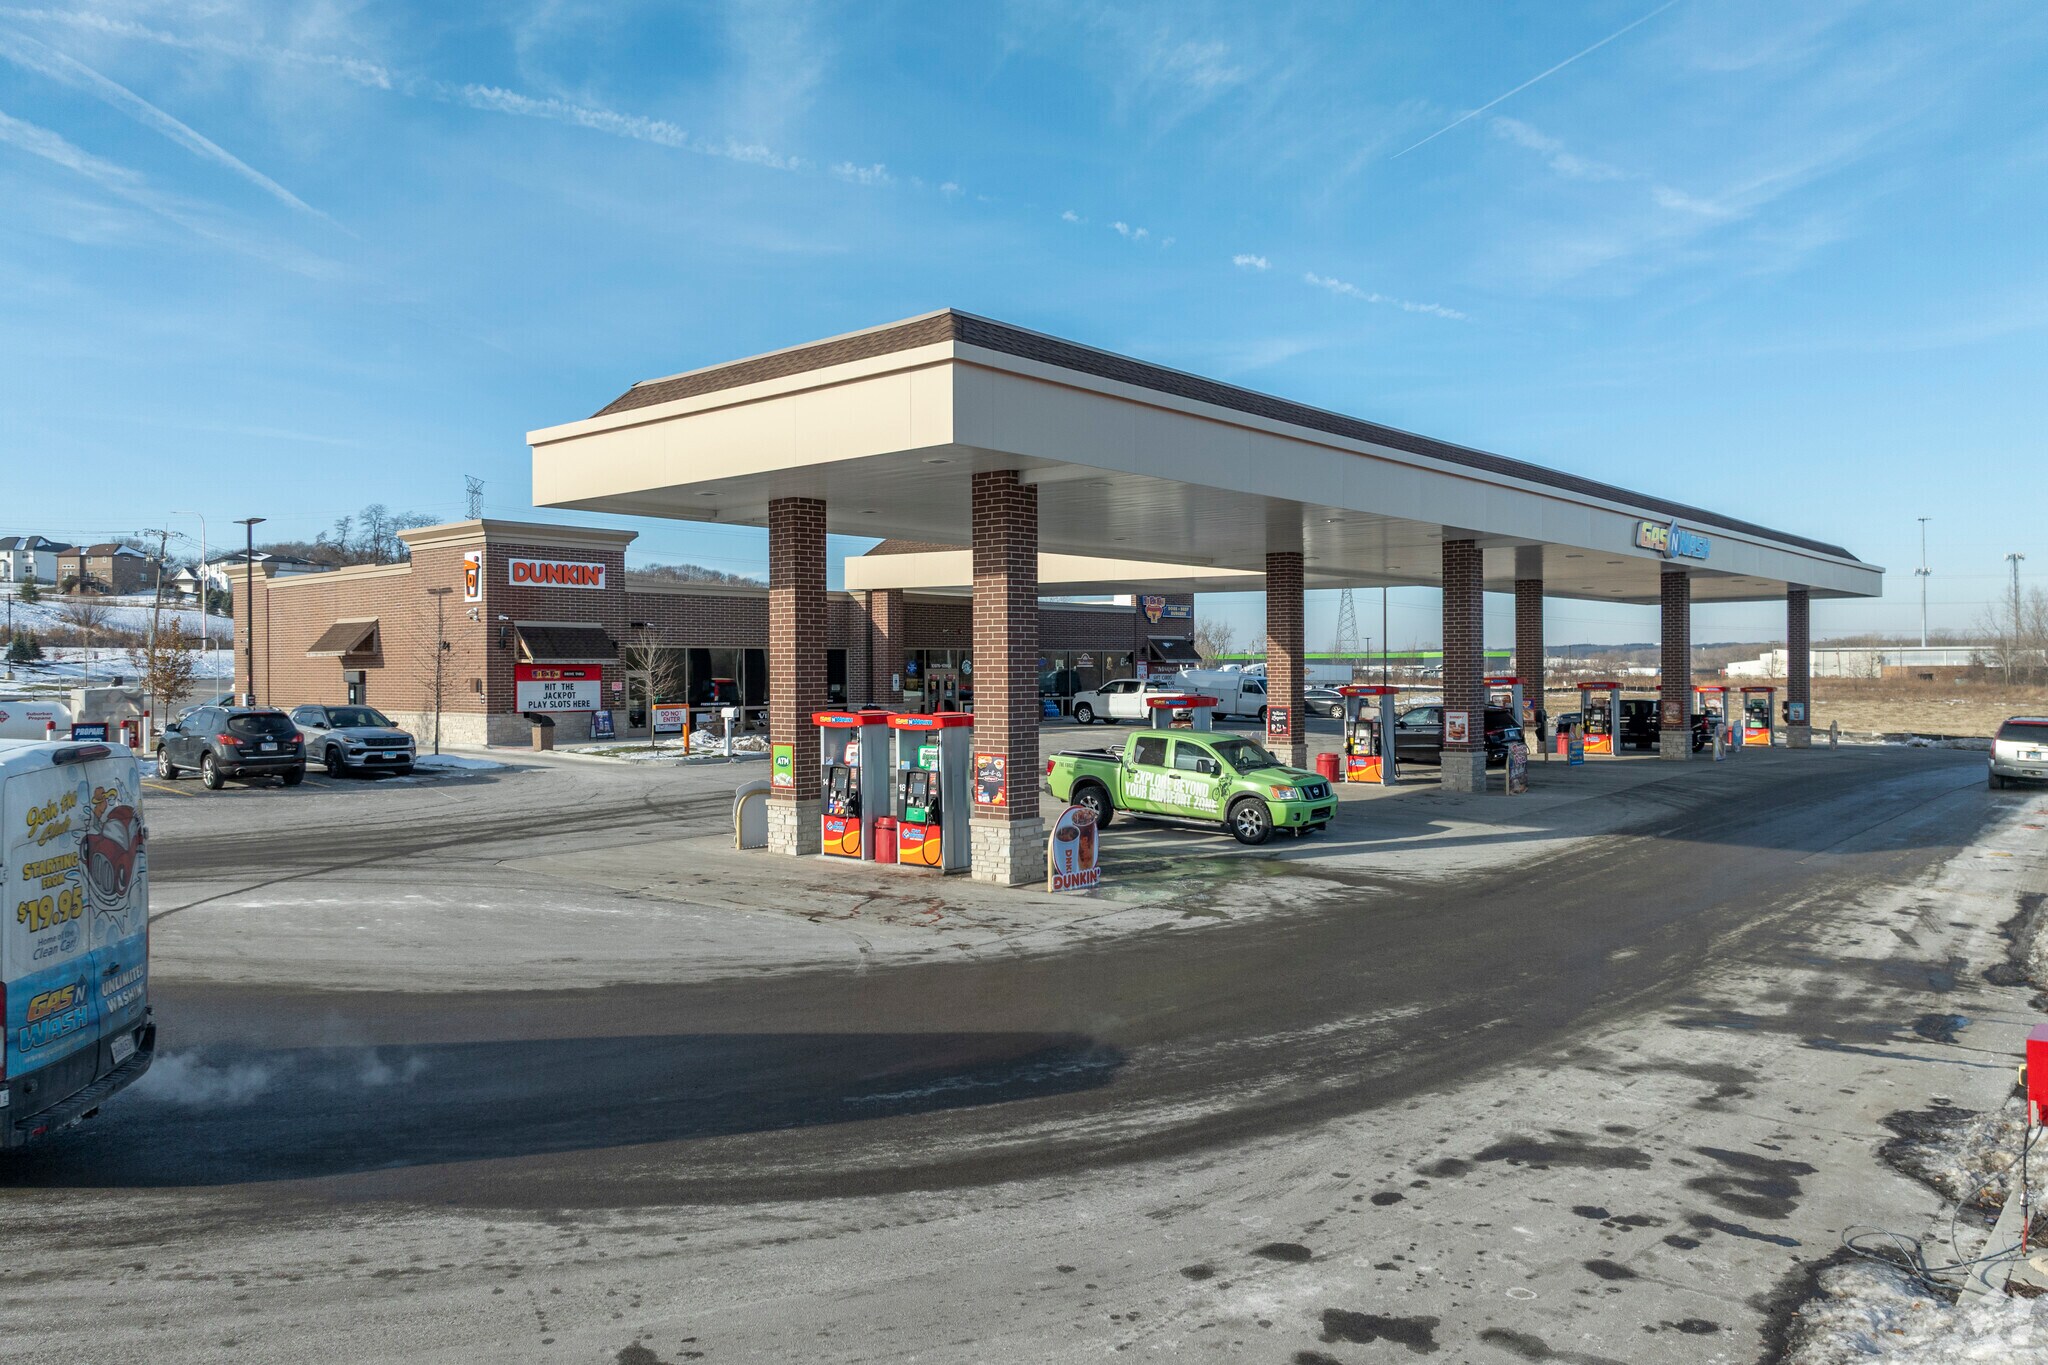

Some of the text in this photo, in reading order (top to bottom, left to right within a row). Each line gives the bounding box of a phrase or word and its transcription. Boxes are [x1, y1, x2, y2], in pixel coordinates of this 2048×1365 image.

[1641, 521, 1712, 559] GAS N WASH
[513, 562, 604, 586] DUNKIN'
[544, 683, 574, 691] HIT THE
[550, 700, 571, 708] SLOTS
[573, 700, 590, 708] HERE
[75, 727, 105, 735] PROPANE
[777, 756, 789, 765] ATM
[899, 784, 906, 792] 18
[1125, 781, 1219, 813] YOUR COMFORT ZONE
[1134, 770, 1209, 798] EXPLORE BEYOND
[26, 790, 78, 838] Join the
[22, 852, 79, 881] STARTING
[1054, 869, 1100, 889] DUNKIN'
[41, 872, 66, 890] FROM
[17, 886, 83, 933] $19.95
[33, 944, 59, 960] Clean
[102, 964, 144, 997] UNLIMITED
[27, 984, 86, 1022] GAS N
[19, 1005, 89, 1053] WASH
